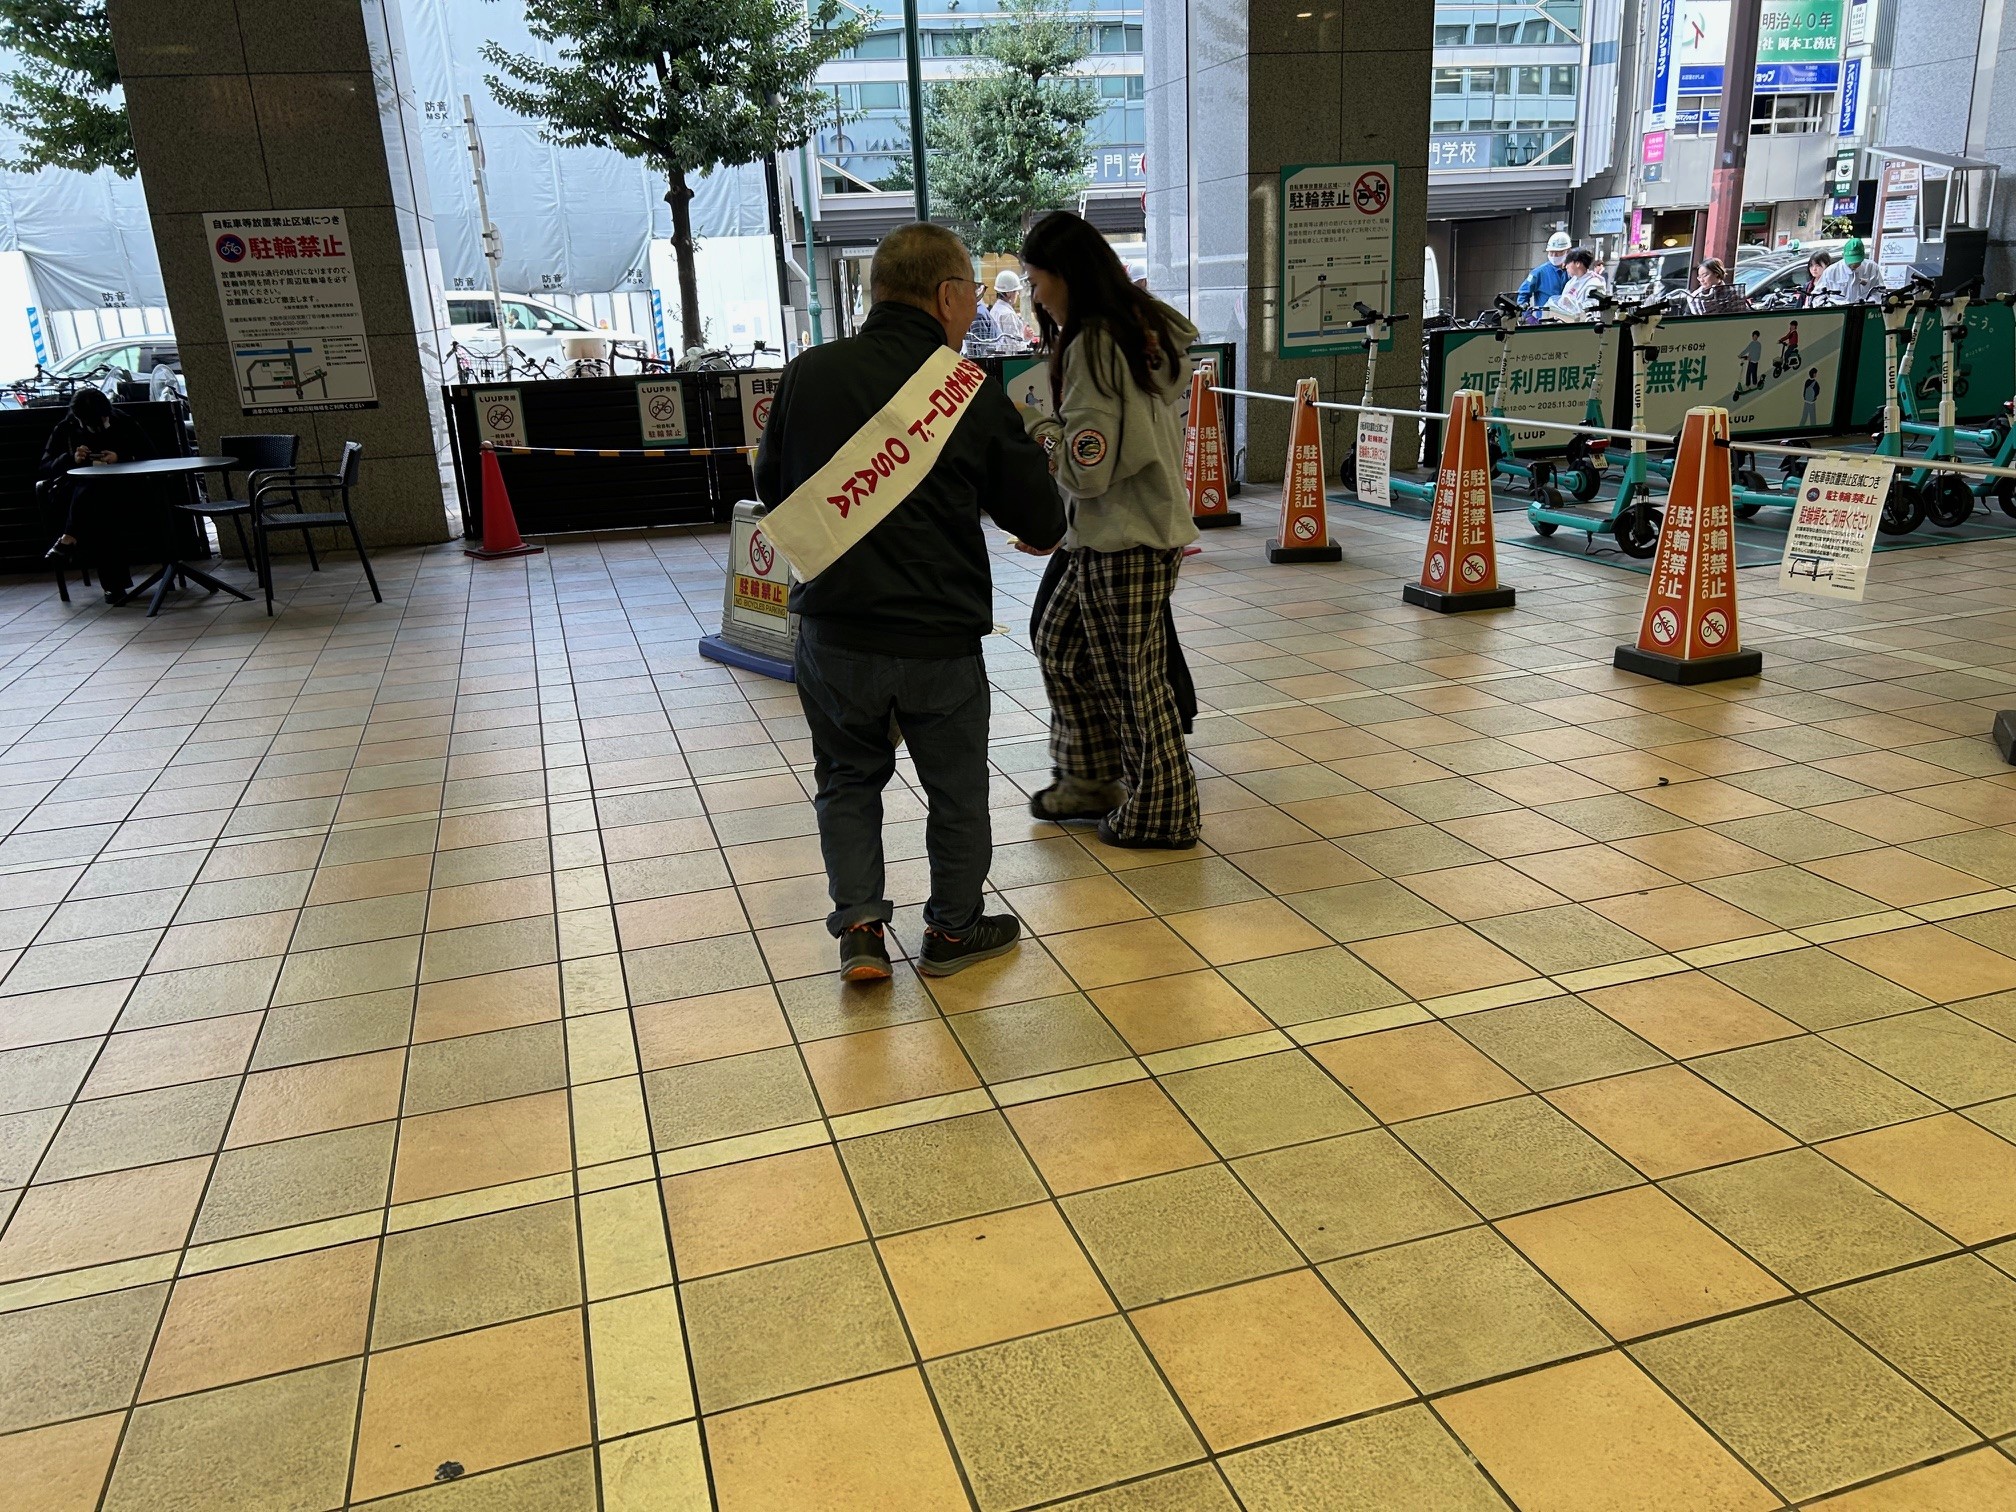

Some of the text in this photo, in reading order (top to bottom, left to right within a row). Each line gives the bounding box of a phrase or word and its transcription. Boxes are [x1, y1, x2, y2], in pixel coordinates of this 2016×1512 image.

[1757, 36, 1836, 51] 社 岡本工務店
[424, 101, 448, 112] 防音
[1289, 190, 1350, 209] 駐輪禁止
[212, 216, 340, 230] 自転車等放置禁止区域につき
[248, 234, 346, 260] 駐輪禁止
[453, 277, 475, 287] 防音
[541, 274, 562, 284] 防音
[627, 268, 644, 278] 防音
[101, 291, 127, 302] 防音
[226, 288, 282, 297] ご利用ください。
[1488, 352, 1569, 364] このートからのご出発で
[1646, 355, 1708, 394] 無料
[1888, 366, 1896, 390] LUUP
[1728, 415, 1755, 424] LUUP
[648, 429, 682, 438] 駐輪禁止
[1200, 427, 1206, 440] NO
[1518, 430, 1546, 440] LUUP
[1206, 426, 1218, 482] 駐輪禁止
[1296, 445, 1302, 460] NO
[826, 437, 911, 519] OSAKA
[1302, 444, 1318, 508] 駐輪禁止
[1808, 470, 1881, 490] 自転車等放置禁止区域につき
[1434, 468, 1446, 542] NO PARKING
[1437, 470, 1456, 545] 駐輪禁止
[1462, 470, 1470, 545] NO PARKING
[1470, 469, 1486, 545] 駐輪禁止
[1824, 490, 1878, 506] 駐輪禁止
[1798, 505, 1874, 530] 駐輪場をご利用ください
[1658, 505, 1676, 596] NO PARKING
[1666, 505, 1694, 600] 駐輪禁止
[1701, 508, 1710, 599] NO PARKING
[1710, 504, 1728, 599] 駐輪禁止
[739, 577, 782, 602] 駐輪禁止
[744, 599, 766, 611] BICYCLES
[766, 605, 786, 616] PARKING
